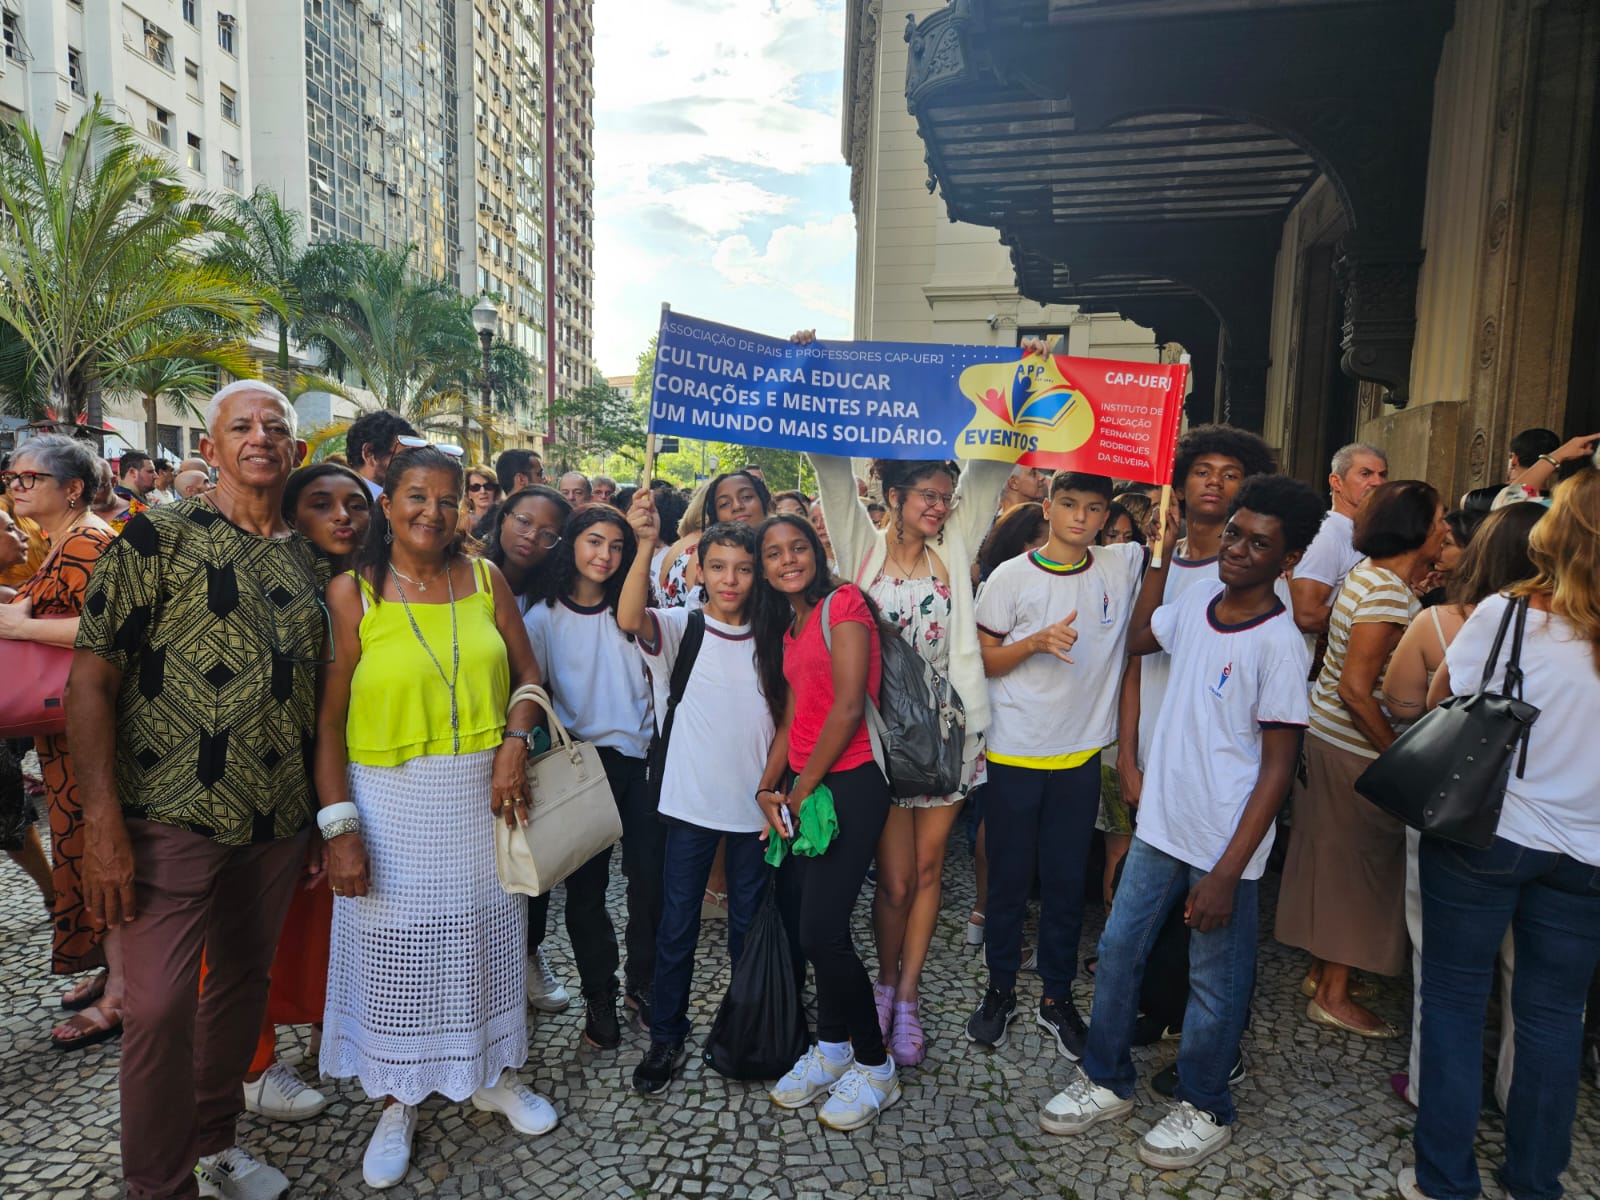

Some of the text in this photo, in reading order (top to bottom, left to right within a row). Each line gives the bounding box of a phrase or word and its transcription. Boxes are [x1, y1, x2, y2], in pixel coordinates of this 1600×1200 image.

[661, 321, 944, 365] ASSOCIAÇÃO DE PAIS E PROFESSORES CAP-UERJ
[658, 345, 891, 391] CULTURA PARA EDUCAR
[1104, 371, 1173, 392] CAP-UERJ
[654, 373, 920, 419] CORAÇÕES E MENTES PARA
[1100, 403, 1164, 416] INSTITUTO DE
[652, 400, 948, 446] UM MUNDO MAIS SOLIDÁRIO.
[1100, 416, 1152, 428] APLICAÇÃO
[964, 429, 1039, 453] EVENTOS
[1100, 428, 1150, 442] FERNANDO
[1100, 440, 1150, 455] RODRIGUES
[1097, 453, 1150, 468] DA SILVEIRA
